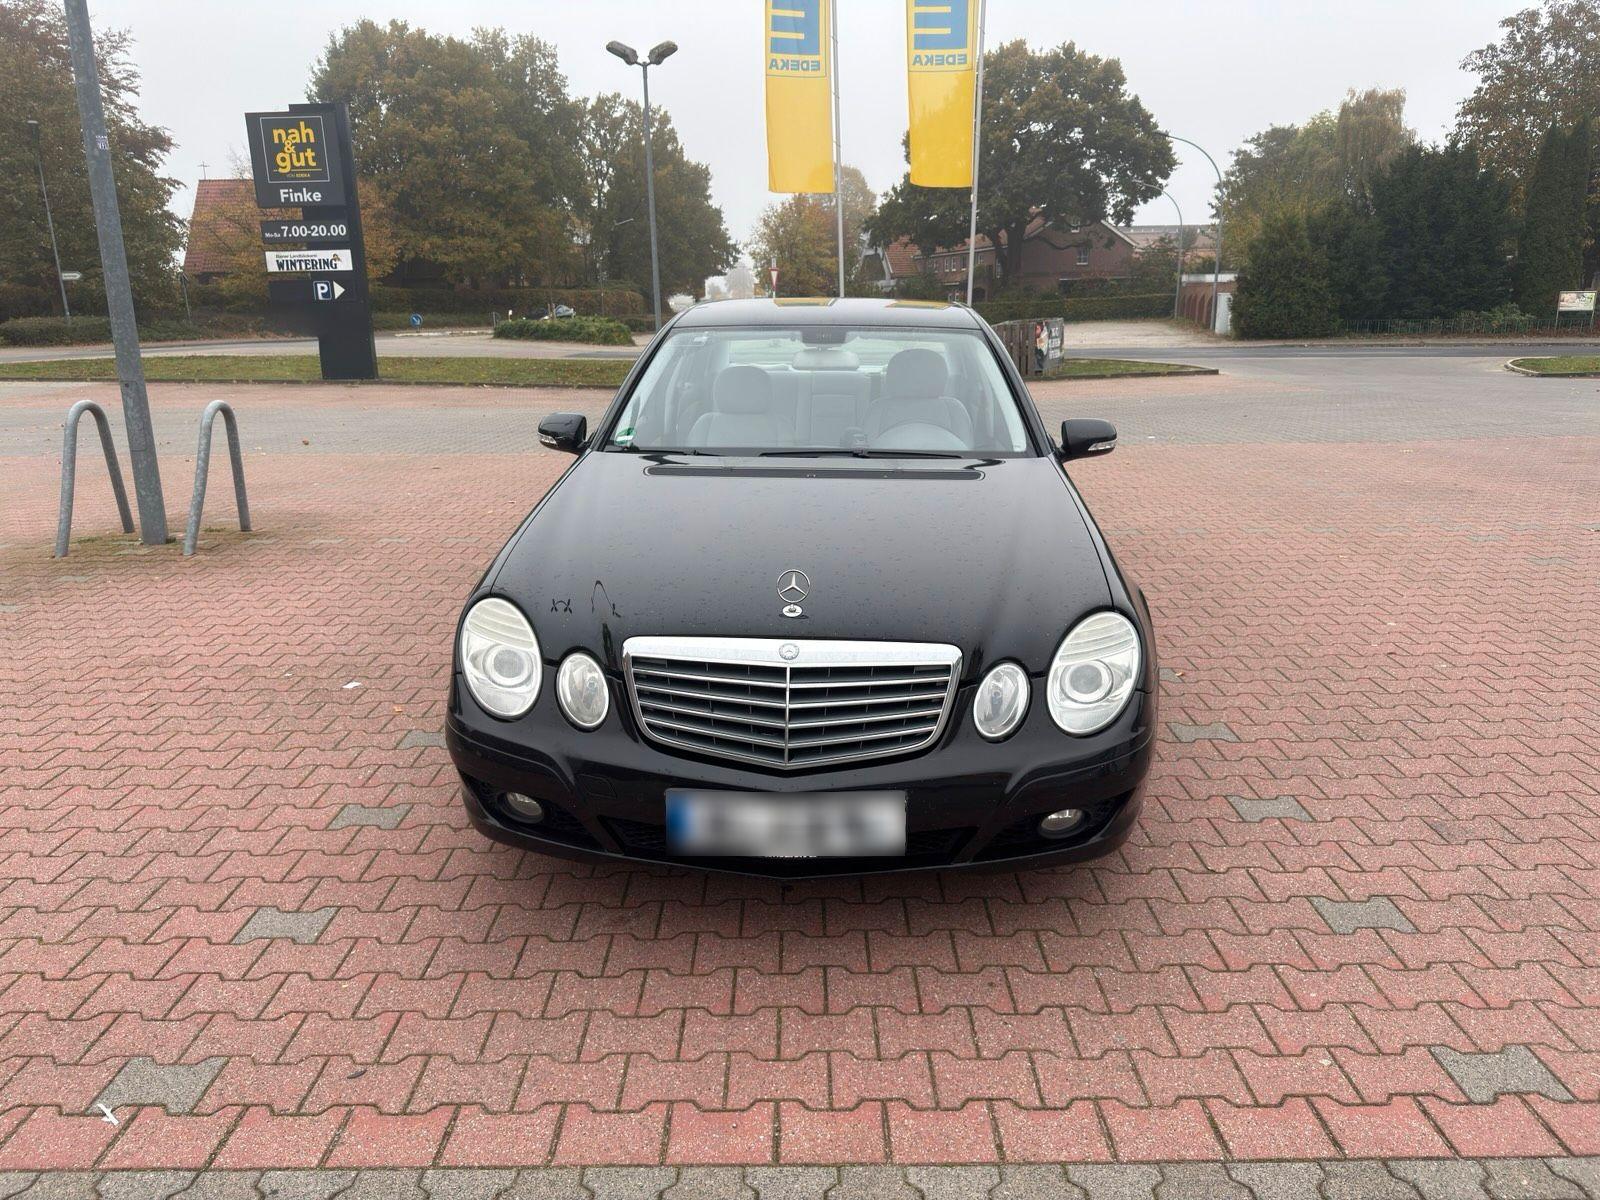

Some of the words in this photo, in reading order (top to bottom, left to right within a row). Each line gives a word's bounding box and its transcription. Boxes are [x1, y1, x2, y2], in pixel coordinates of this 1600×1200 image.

[272, 121, 315, 144] nah
[284, 139, 296, 153] &
[276, 148, 317, 173] gut
[279, 187, 322, 203] Finke
[280, 224, 347, 237] 7.00-20.00
[275, 258, 338, 271] WINTERING
[316, 283, 329, 300] P
